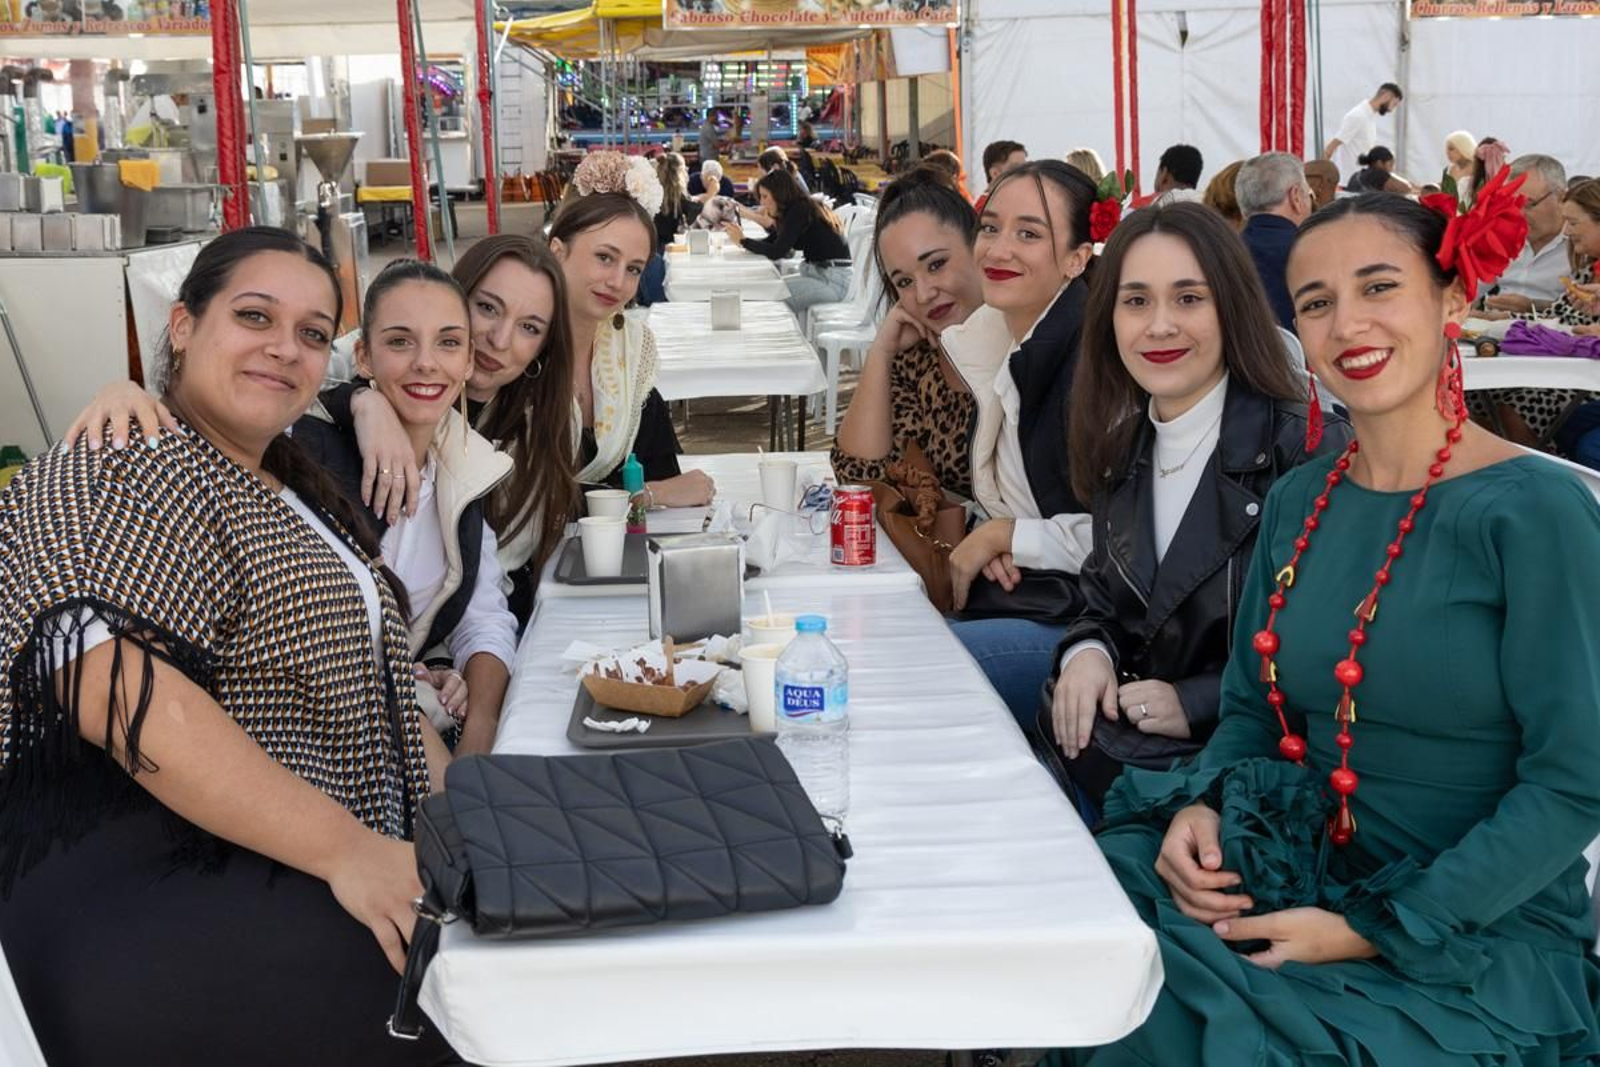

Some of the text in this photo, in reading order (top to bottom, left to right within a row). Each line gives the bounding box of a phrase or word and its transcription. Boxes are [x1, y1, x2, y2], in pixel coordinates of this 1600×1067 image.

[1415, 1, 1471, 15] Churros
[1477, 0, 1539, 14] Rellenos
[1541, 3, 1551, 16] y
[739, 9, 817, 23] Chocolate
[23, 19, 68, 33] Zumos
[85, 18, 151, 33] Refrescos
[786, 688, 821, 699] AQUA
[787, 697, 821, 710] DEUS
